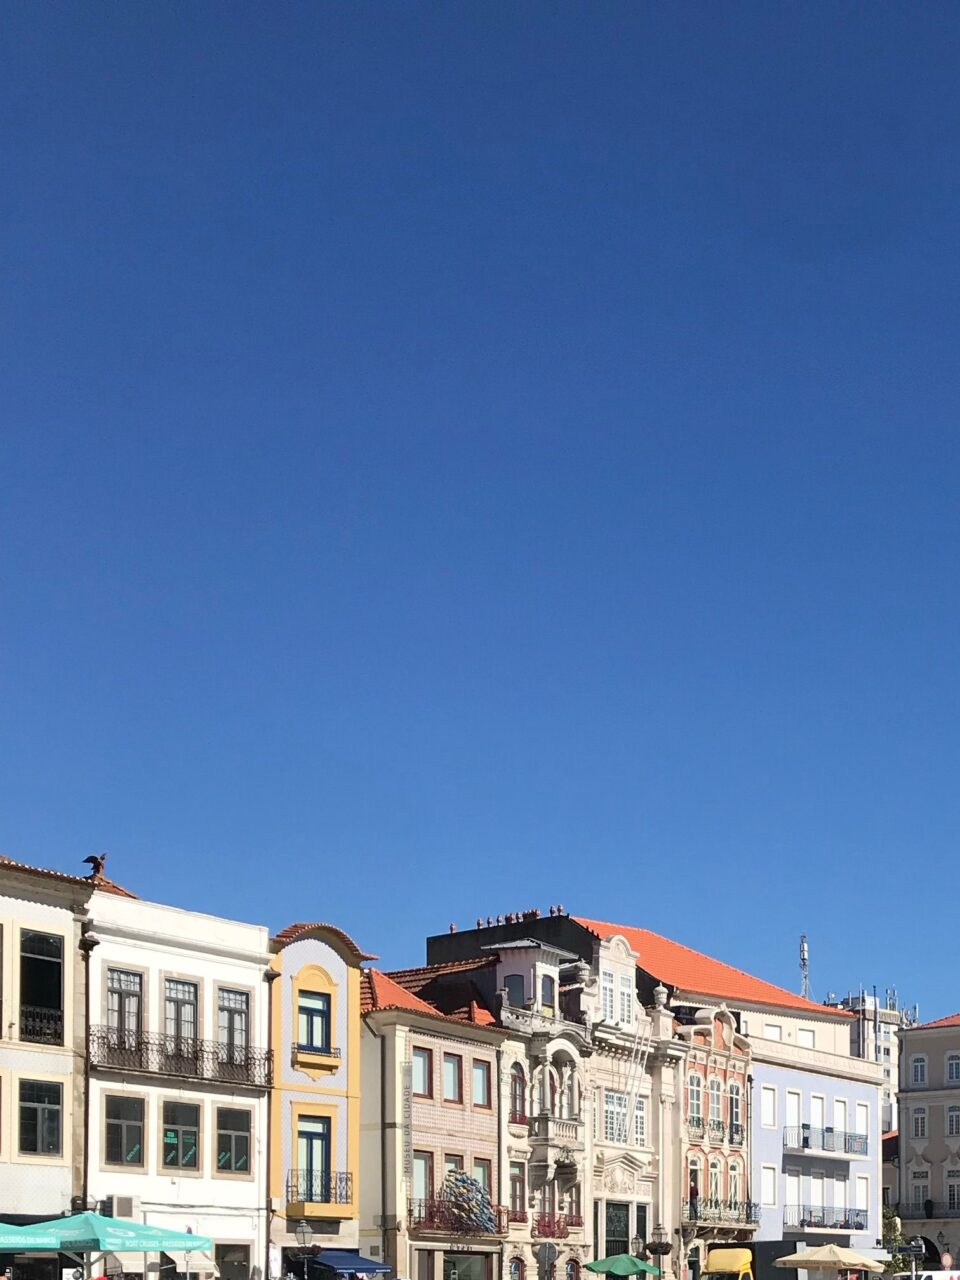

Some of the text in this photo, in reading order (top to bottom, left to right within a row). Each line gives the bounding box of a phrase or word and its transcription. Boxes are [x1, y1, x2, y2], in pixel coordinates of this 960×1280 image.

[403, 1085, 412, 1174] MUSEU DA CIDADE
